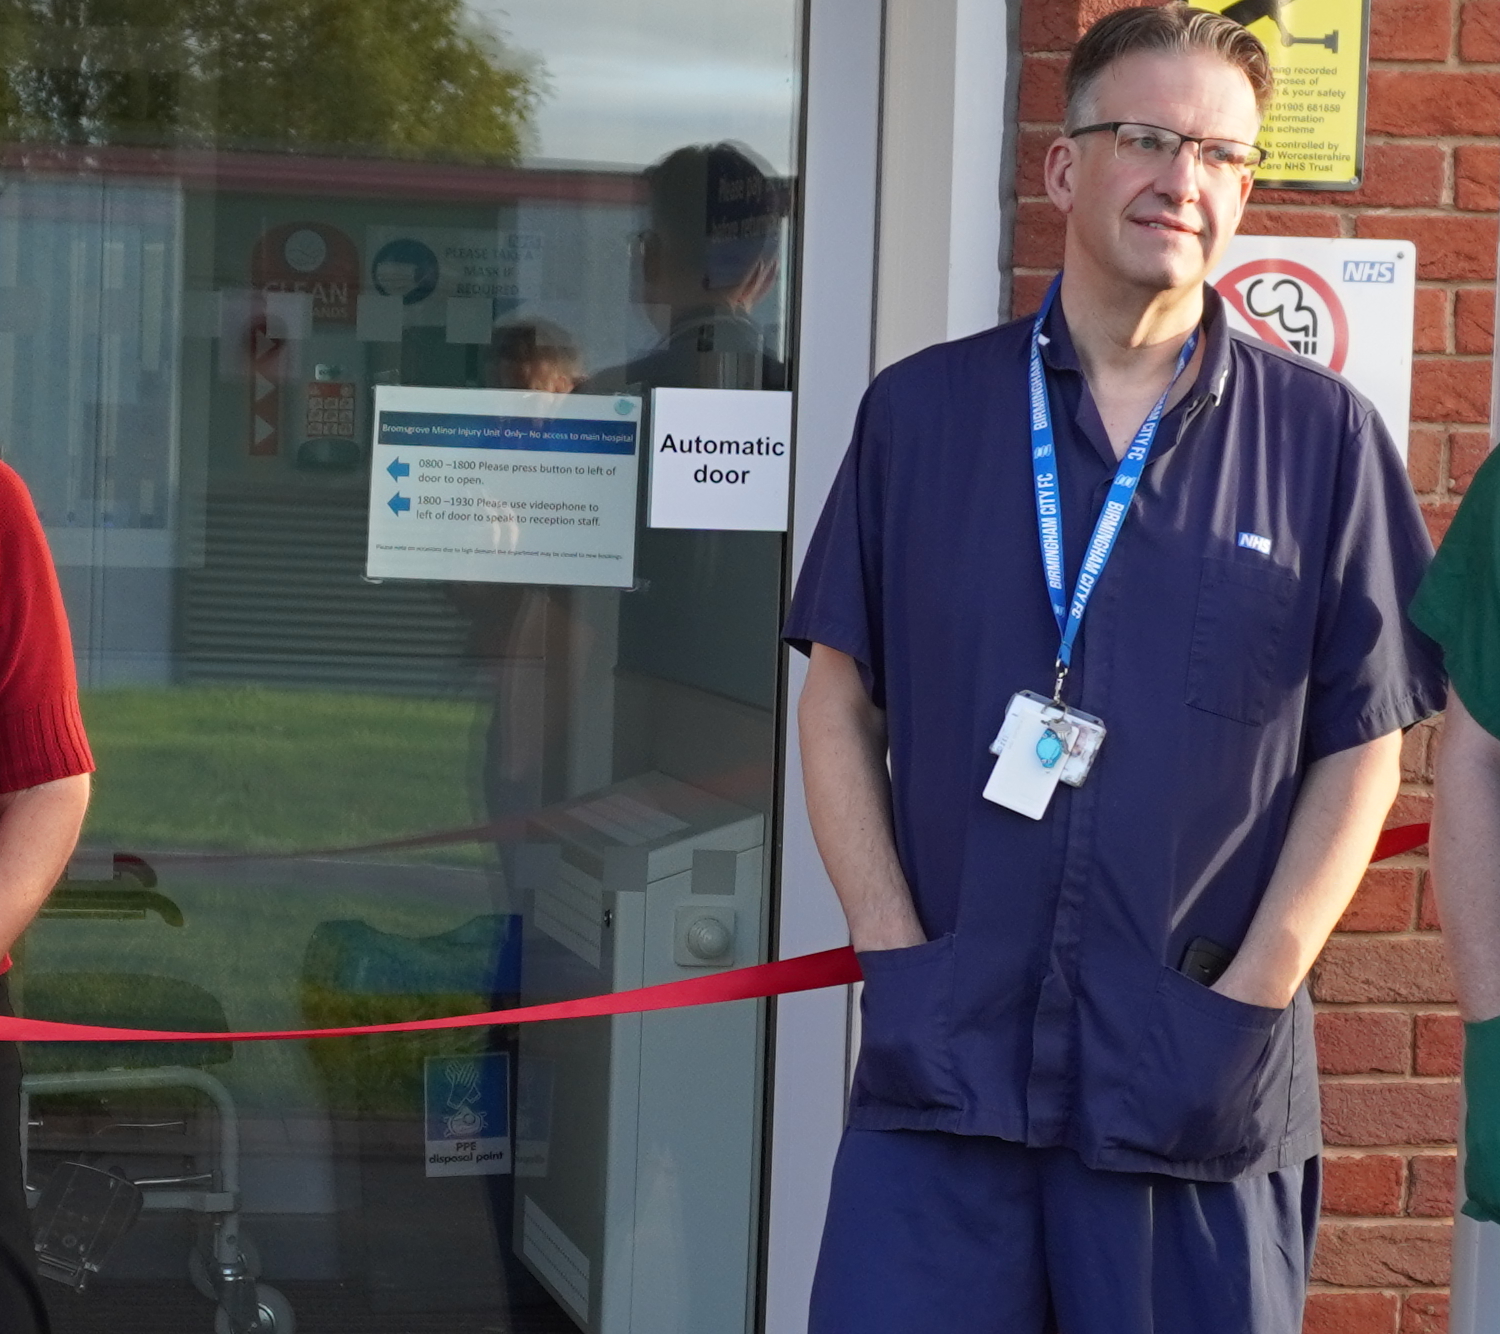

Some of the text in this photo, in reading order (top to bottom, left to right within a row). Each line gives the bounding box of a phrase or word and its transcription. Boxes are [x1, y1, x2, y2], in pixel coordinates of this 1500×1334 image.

[1271, 66, 1337, 75] eing recorded
[1272, 78, 1306, 86] rposes
[1282, 88, 1289, 96] &
[1292, 89, 1314, 98] your
[1317, 89, 1346, 99] safety
[1260, 124, 1274, 132] his
[1276, 141, 1324, 149] controlled
[1328, 142, 1339, 151] by
[1278, 151, 1351, 161] Worcestershire
[1284, 163, 1306, 171] NHS
[1309, 163, 1334, 172] Trust
[1344, 262, 1393, 282] NHS
[312, 306, 348, 318] ANDS
[1030, 359, 1048, 431] BIRMINGHAM
[432, 426, 456, 435] Minor
[458, 427, 481, 438] Injury
[483, 428, 500, 437] Unit
[529, 430, 540, 439] No
[542, 432, 568, 440] access
[570, 432, 578, 440] to
[602, 434, 634, 444] hospital
[660, 433, 785, 457] Automatic
[1128, 446, 1146, 461] FC
[419, 459, 443, 469] 0800
[478, 461, 509, 472] Please
[512, 464, 537, 475] press
[540, 464, 572, 474] button
[575, 466, 585, 475] to
[587, 466, 603, 476] left
[606, 466, 617, 476] of
[693, 465, 750, 485] door
[419, 473, 484, 486] door to open.
[417, 496, 441, 506] 1800
[476, 498, 507, 509] Please
[510, 501, 527, 509] use
[529, 500, 587, 513] videophone
[589, 504, 599, 512] to
[416, 511, 433, 520] left
[435, 510, 446, 520] of
[448, 512, 471, 522] door
[473, 513, 484, 522] to
[486, 513, 514, 525] speak
[517, 515, 527, 523] to
[529, 516, 575, 527] reception
[1037, 472, 1062, 590] BIRMINGHAM CITY FC
[1240, 533, 1271, 554] NHS
[1071, 500, 1125, 620] BIRMINGHAM CITY FC
[456, 1142, 477, 1152] PPE
[429, 1152, 473, 1165] disposal
[476, 1151, 504, 1163] point
